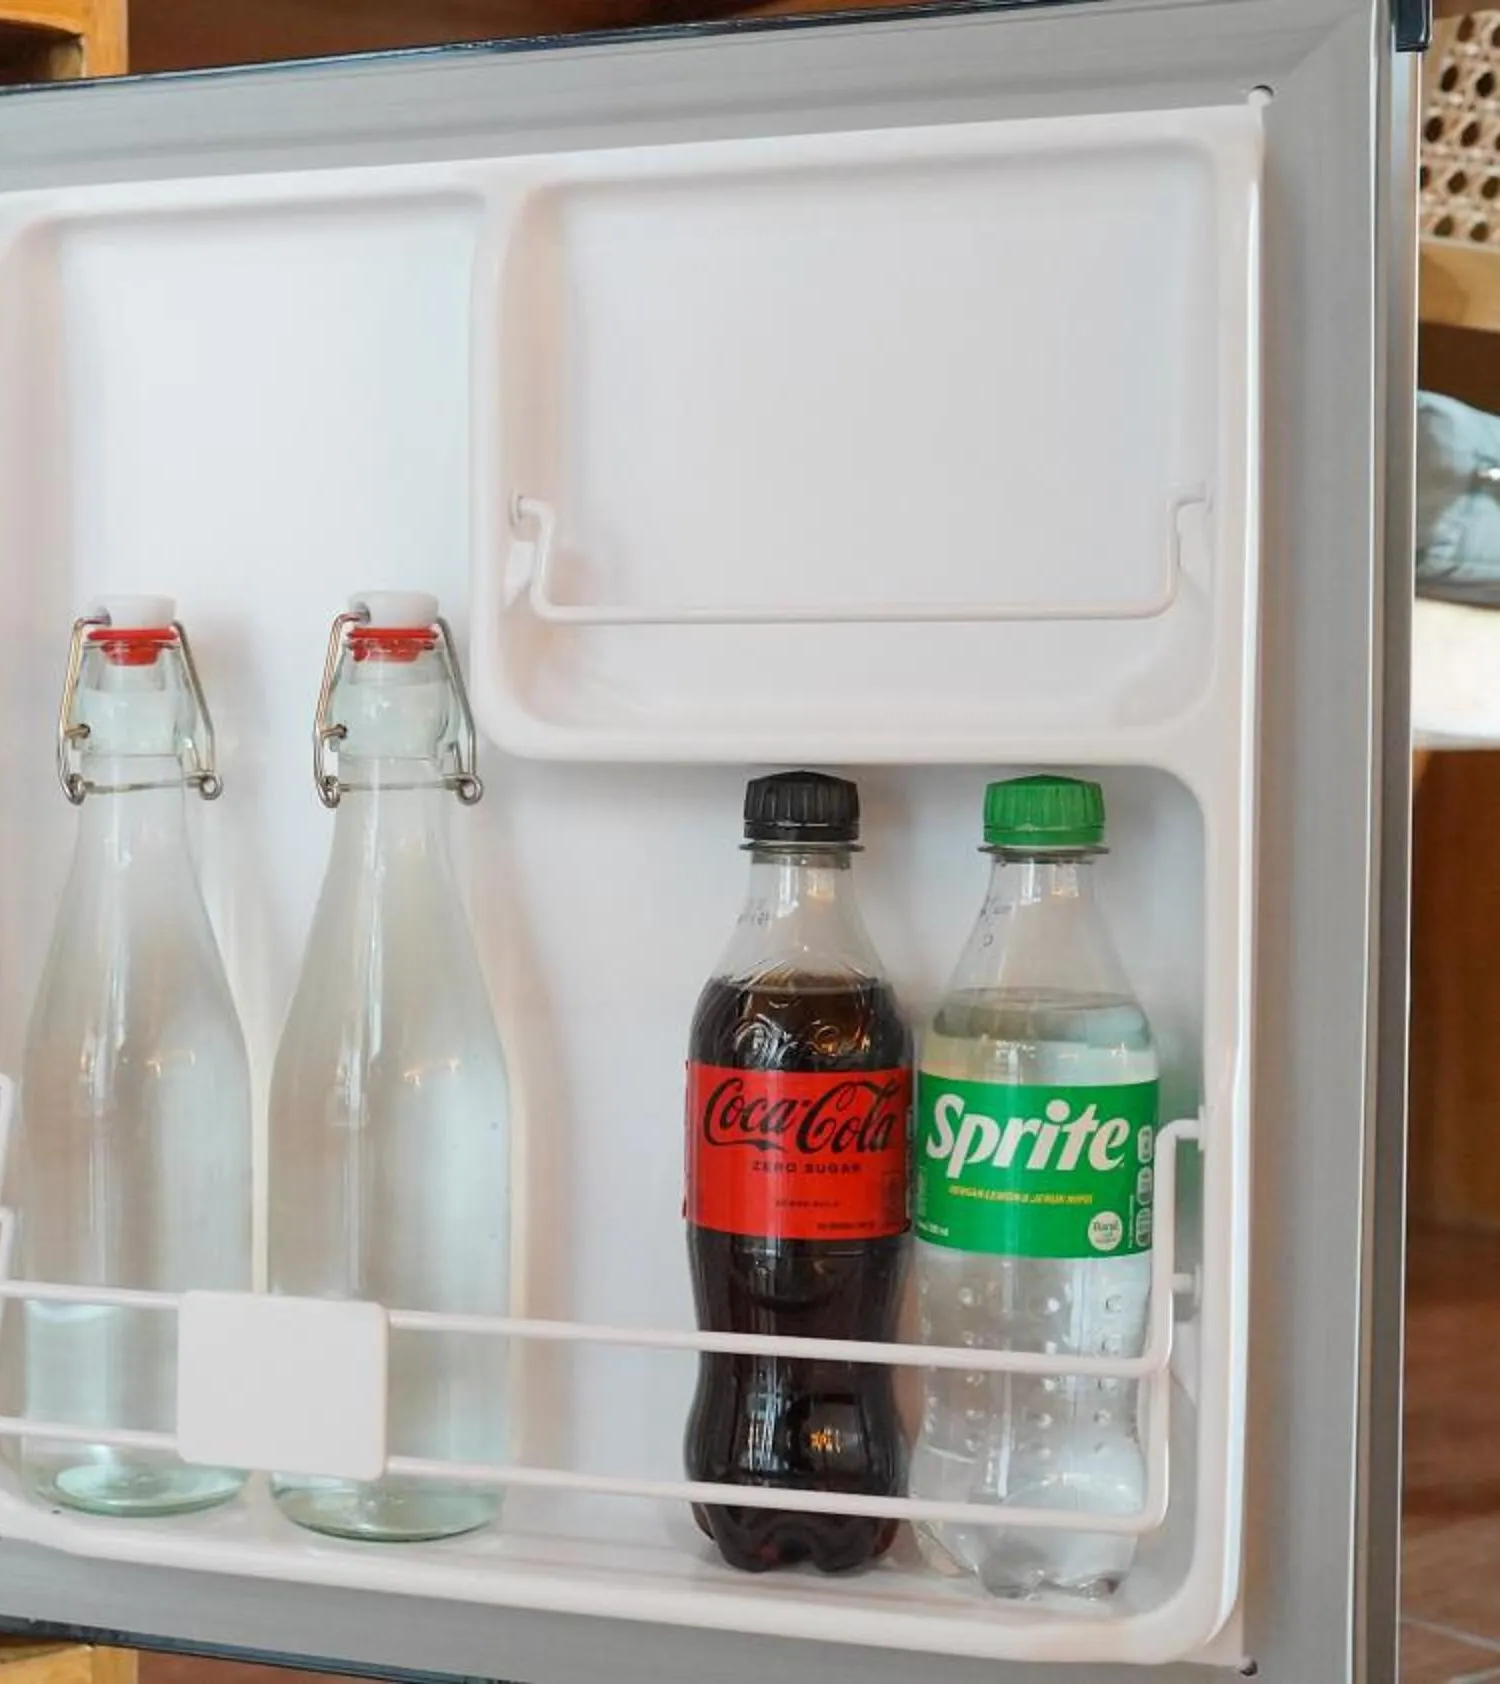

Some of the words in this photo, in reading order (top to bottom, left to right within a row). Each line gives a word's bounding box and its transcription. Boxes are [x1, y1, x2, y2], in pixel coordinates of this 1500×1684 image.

[926, 1093, 1130, 1179] Sprite
[752, 1160, 797, 1174] ZERO
[804, 1162, 862, 1175] SUGAR
